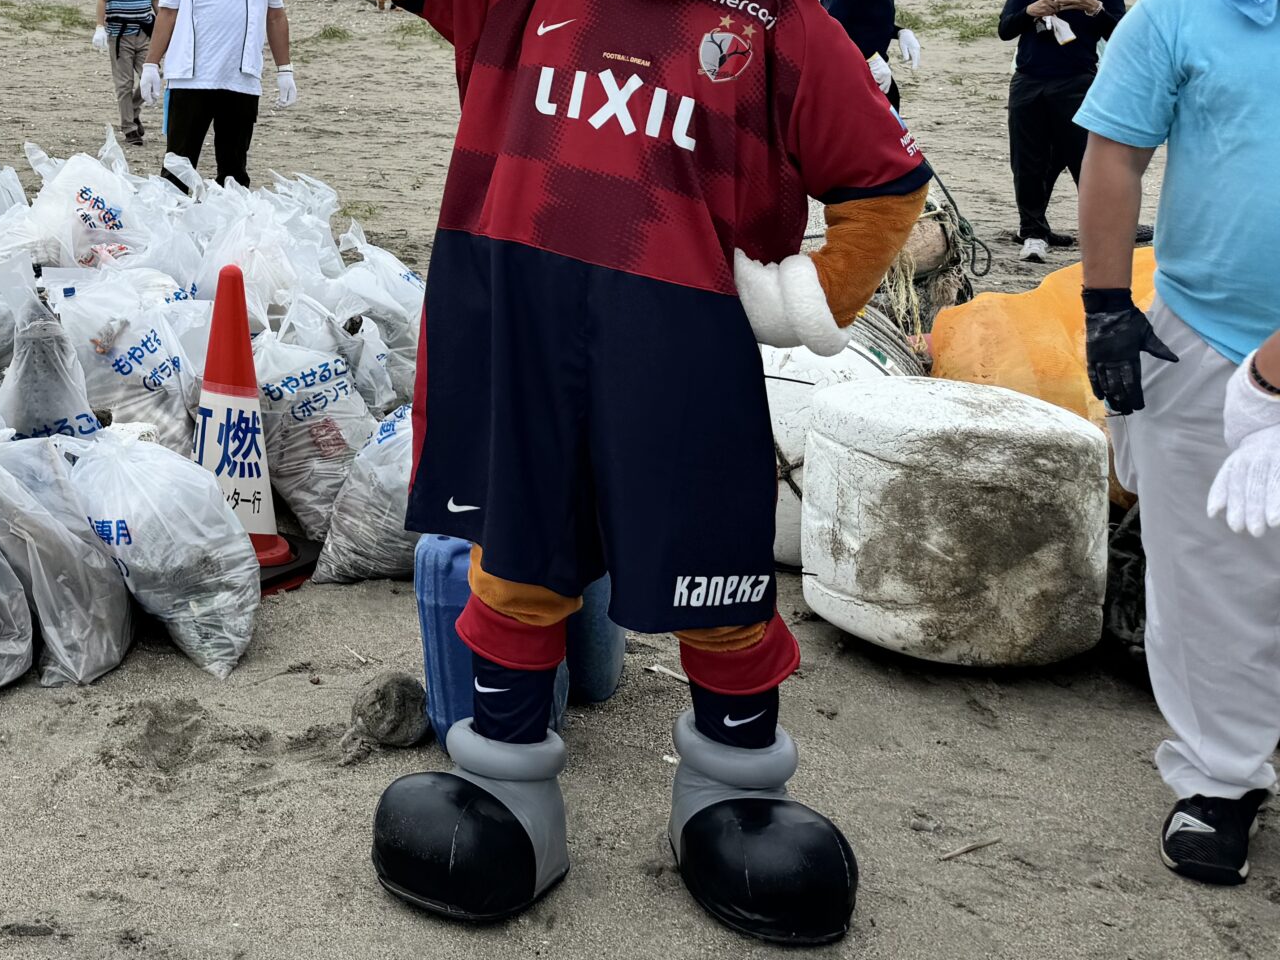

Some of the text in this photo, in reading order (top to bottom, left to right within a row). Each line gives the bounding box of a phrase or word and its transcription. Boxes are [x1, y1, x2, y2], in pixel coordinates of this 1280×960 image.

[602, 51, 651, 68] FOOTBALL DREAM
[535, 66, 697, 152] LIXIL
